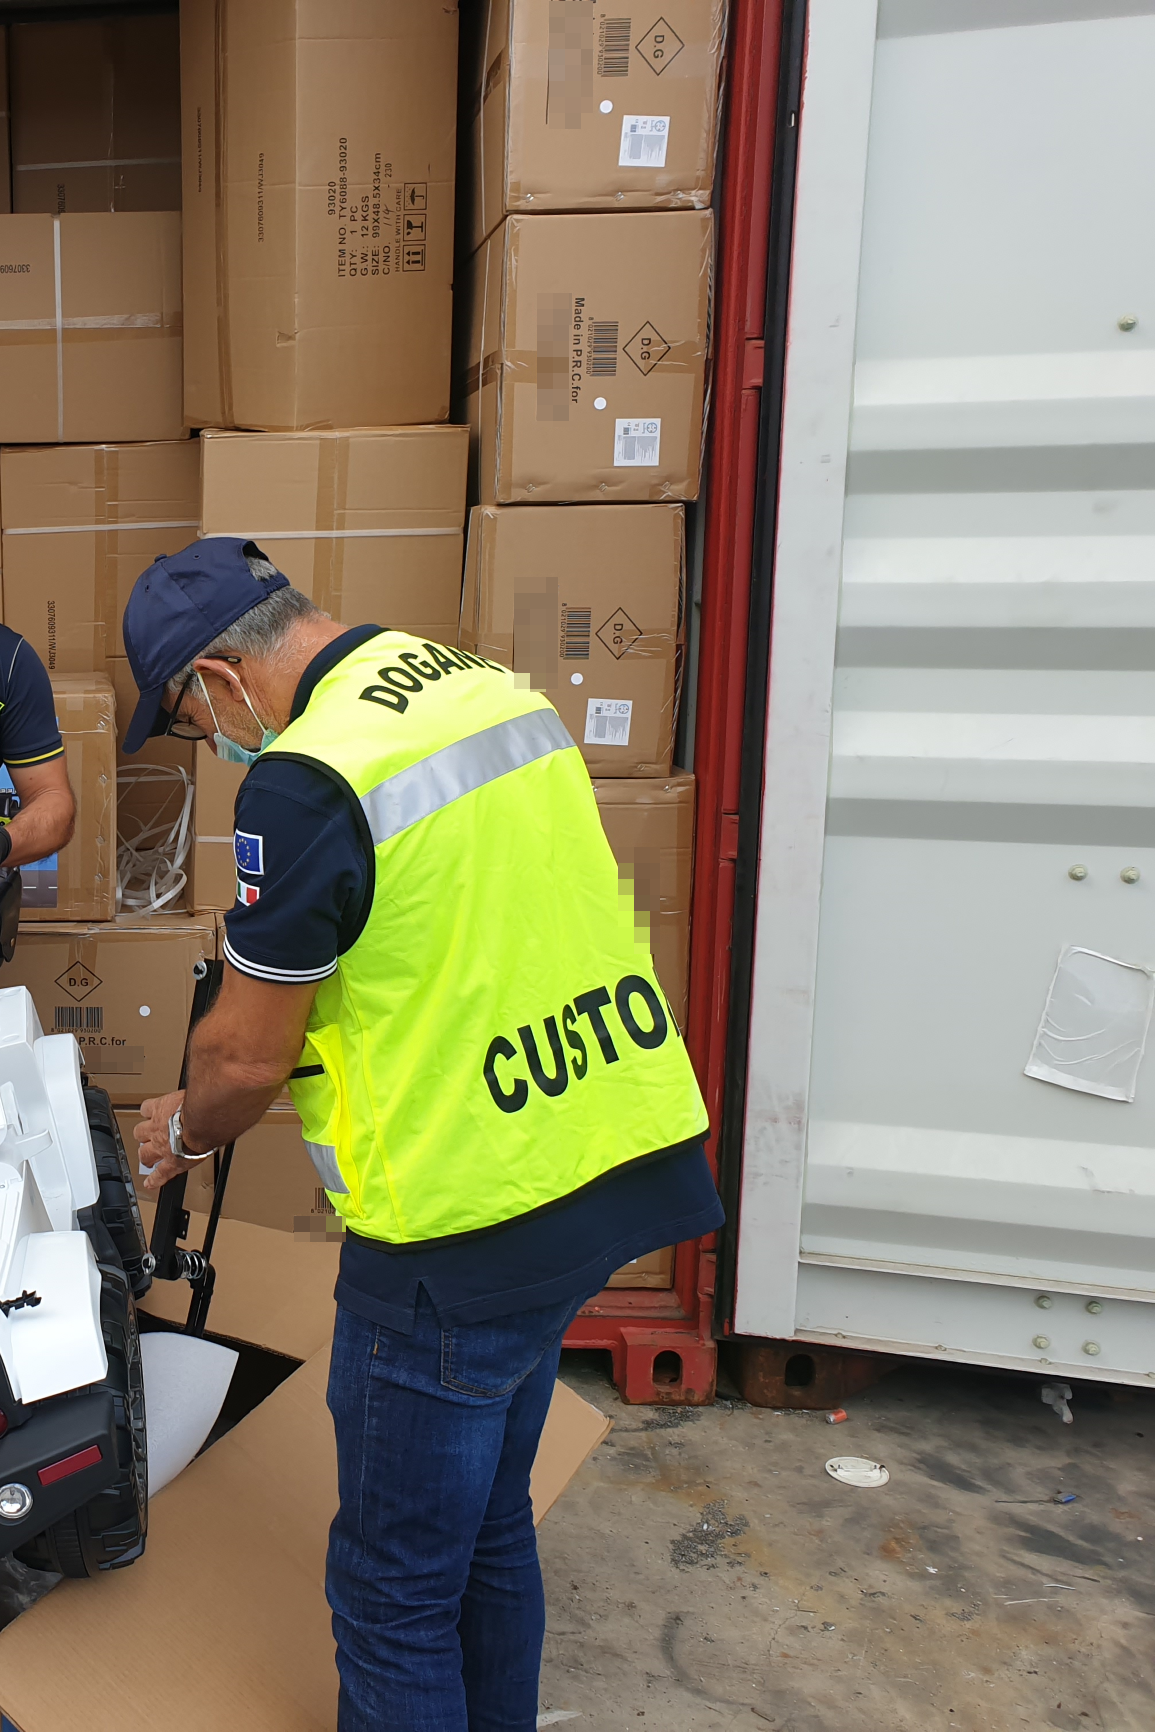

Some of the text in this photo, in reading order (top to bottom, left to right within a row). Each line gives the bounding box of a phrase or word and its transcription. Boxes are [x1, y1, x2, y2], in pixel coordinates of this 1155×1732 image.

[653, 34, 665, 59] D.G
[384, 162, 393, 178] 230
[328, 181, 337, 216] 93020
[338, 137, 348, 278] ITEM NO. TY6088-93020
[361, 195, 370, 222] KGS
[350, 205, 358, 223] PC
[371, 152, 381, 276] SIZE: 99X48.5X34cm
[361, 225, 369, 239] 12
[349, 248, 358, 277] QTY:
[382, 241, 391, 276] C/NO.
[573, 297, 585, 331] Made
[572, 334, 583, 346] in
[640, 337, 652, 360] D.G
[47, 600, 57, 670] 3307609311/WJ3049
[612, 623, 624, 645] D.G
[68, 977, 89, 987] D.G
[482, 974, 681, 1114] CUSTO
